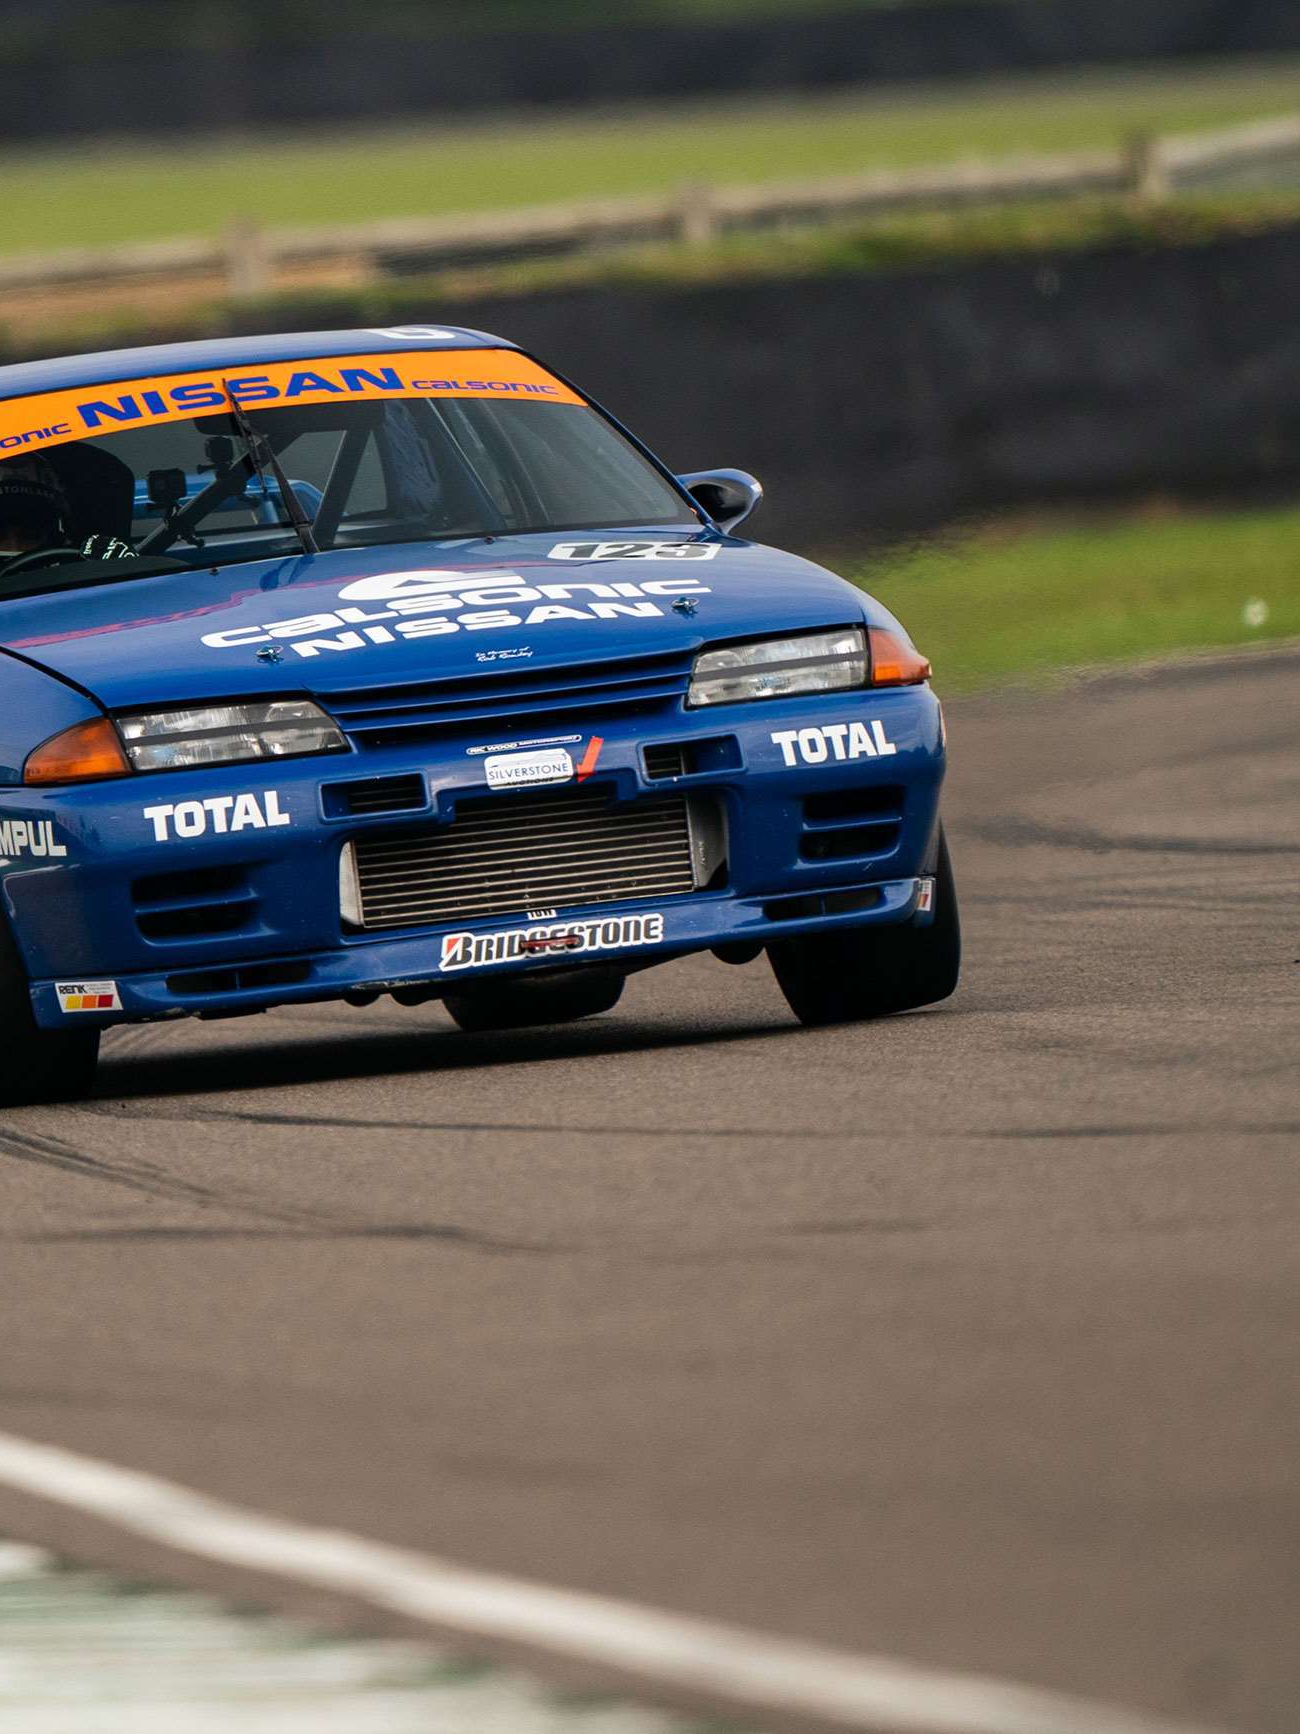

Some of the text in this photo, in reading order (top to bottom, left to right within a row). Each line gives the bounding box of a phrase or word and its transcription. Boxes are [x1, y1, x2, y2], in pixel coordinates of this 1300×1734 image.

[76, 367, 405, 429] NISSAN
[556, 543, 709, 560] 123
[289, 602, 665, 658] NISSAN
[770, 720, 897, 767] TOTAL
[488, 762, 569, 780] SILVERSTONE
[144, 791, 290, 841] TOTAL
[442, 915, 662, 968] BRIDGESTONE
